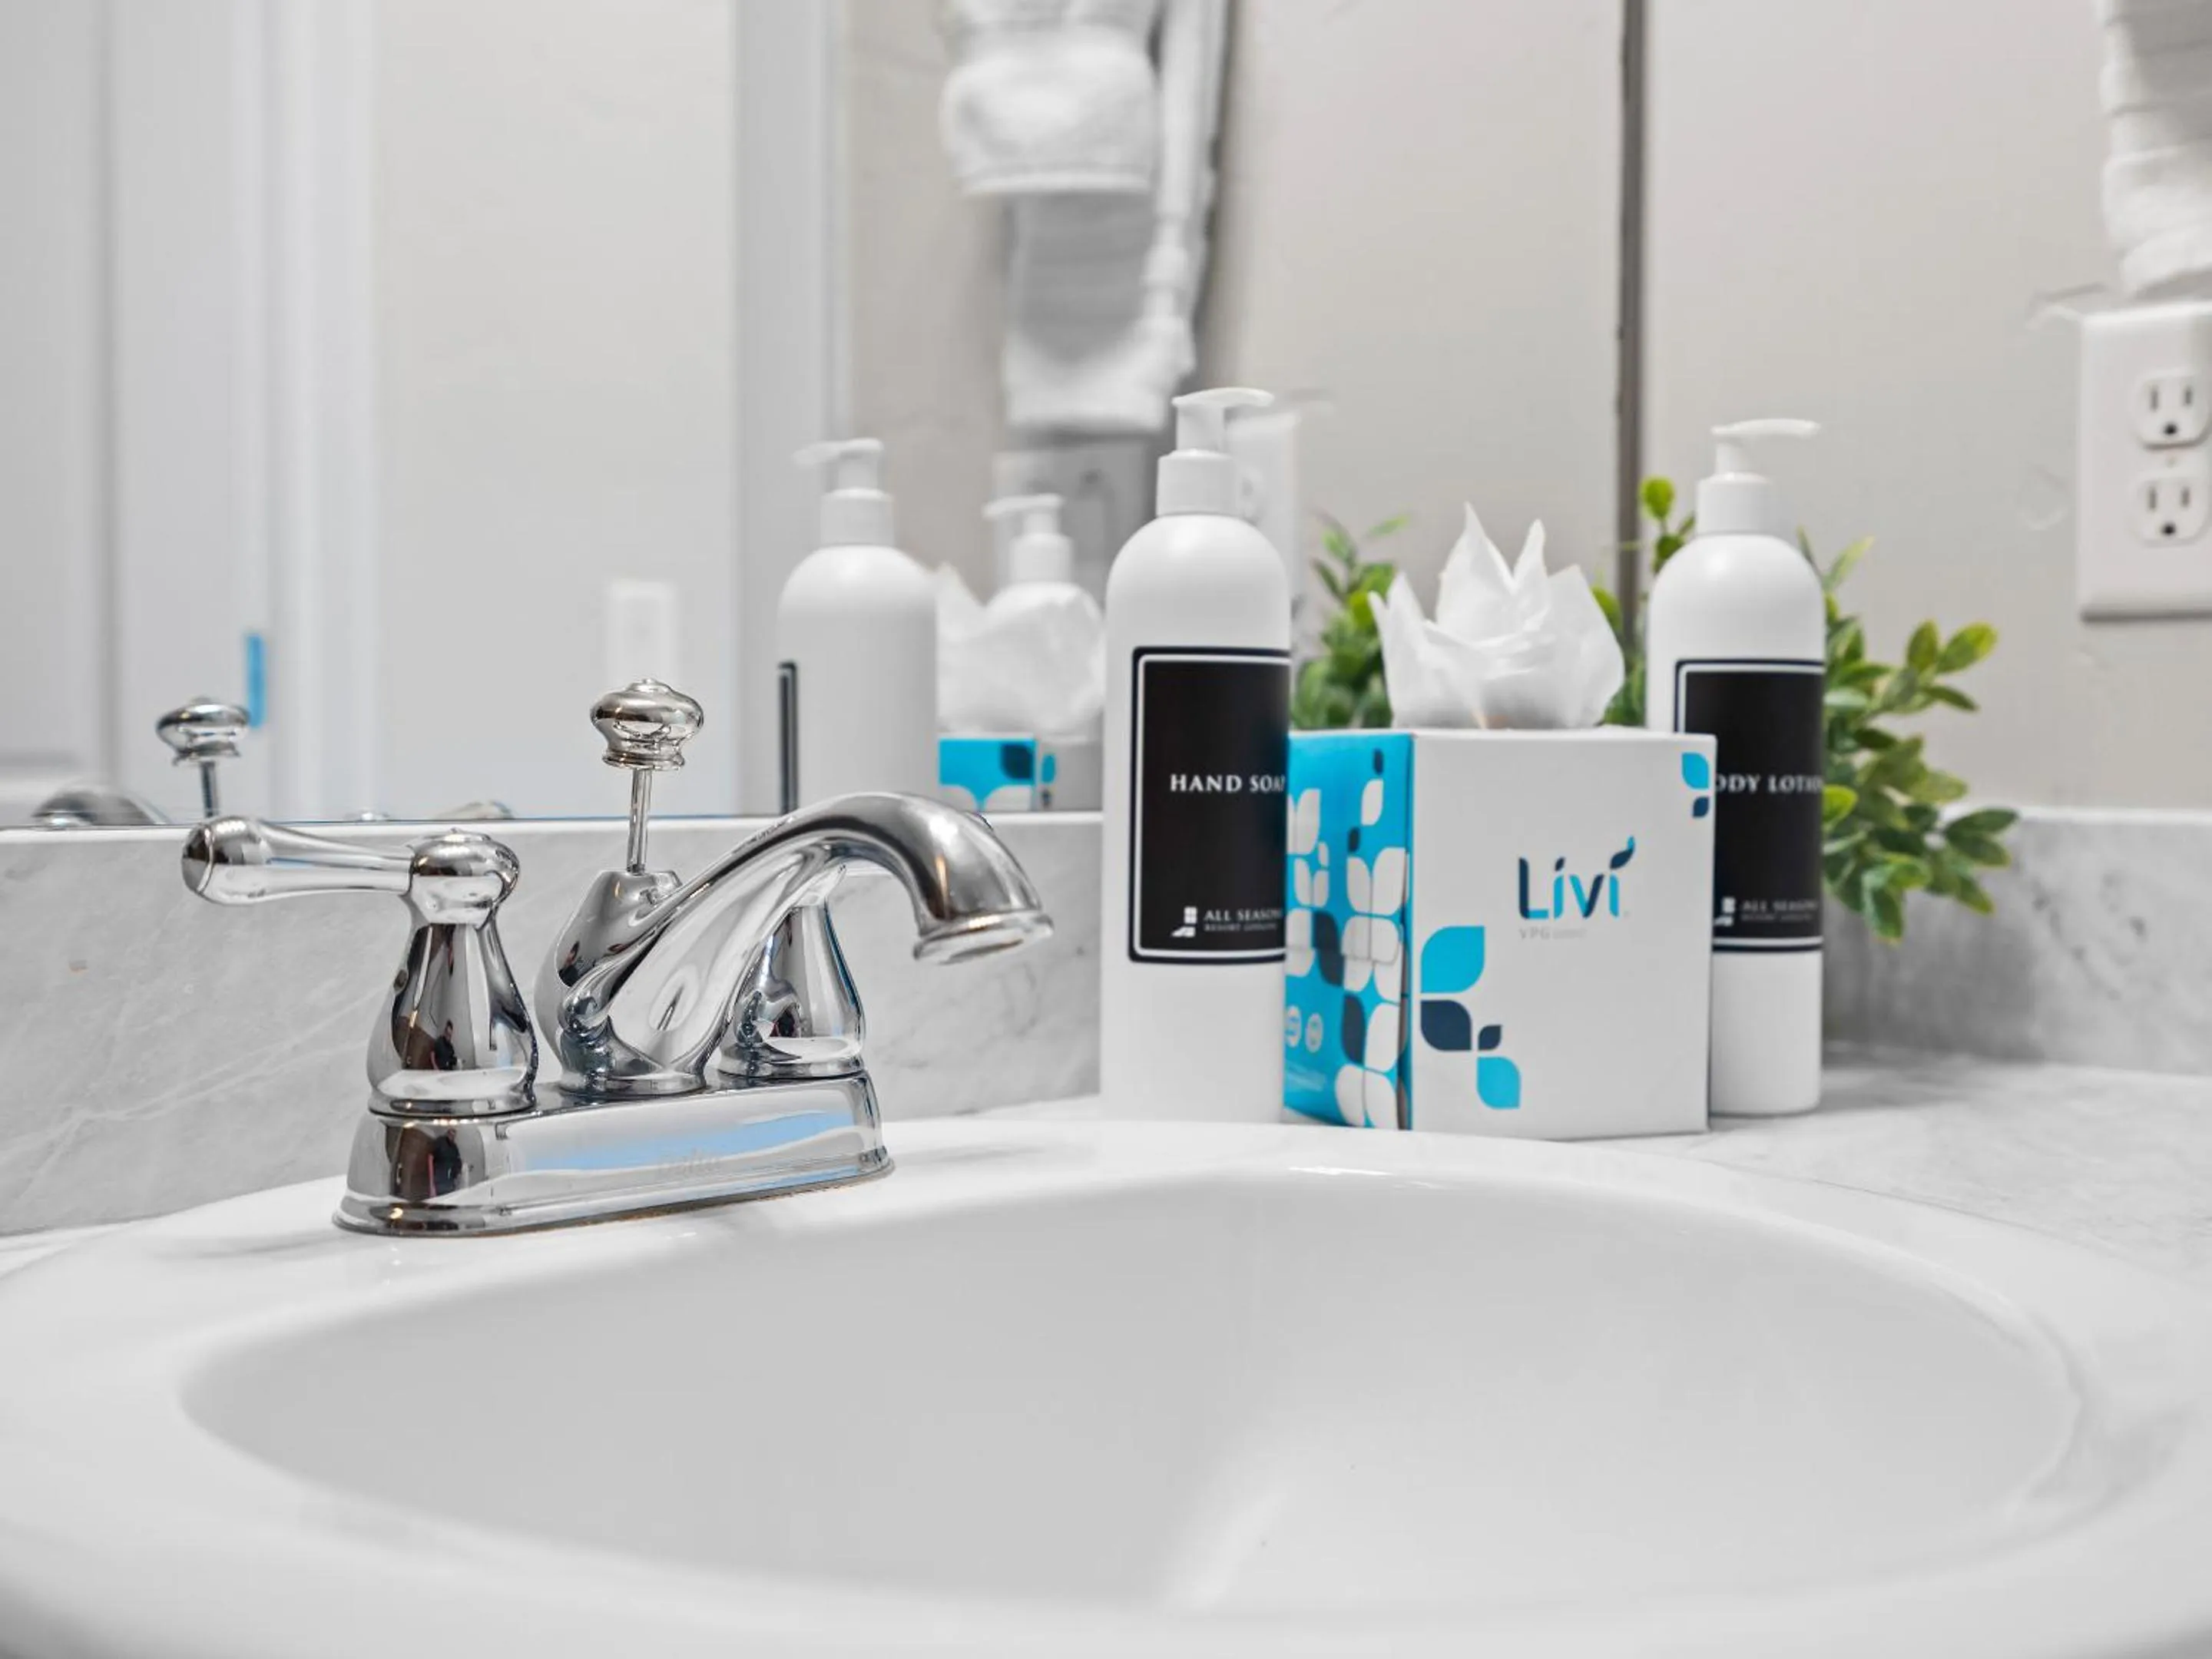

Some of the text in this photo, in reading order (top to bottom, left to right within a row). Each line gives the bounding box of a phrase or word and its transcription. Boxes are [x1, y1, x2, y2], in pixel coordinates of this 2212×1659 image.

[1171, 773, 1243, 793] HAND
[1716, 773, 1823, 793] ODY LOTIO
[1518, 835, 1635, 919] Livi
[1204, 909, 1231, 922] ALL
